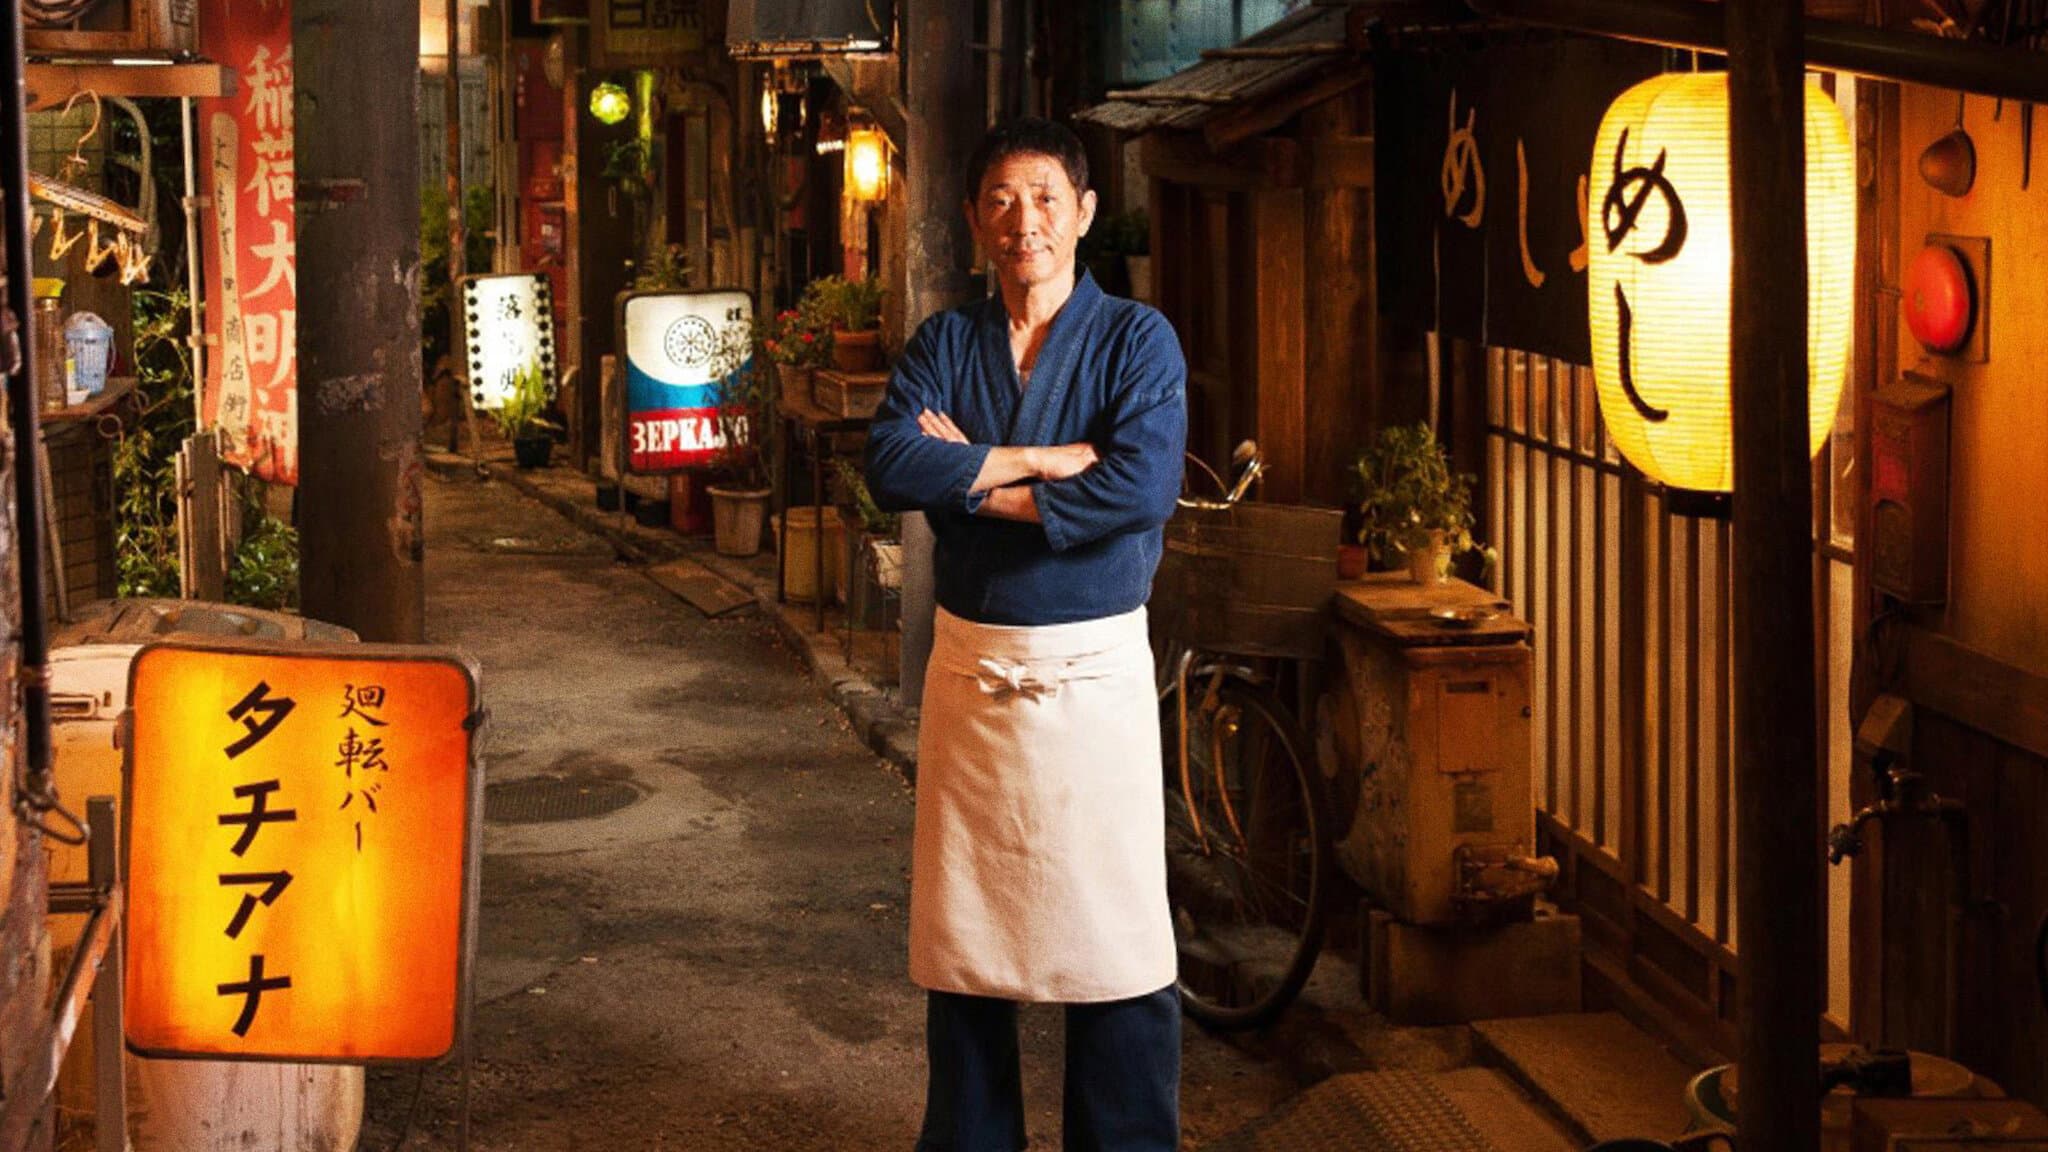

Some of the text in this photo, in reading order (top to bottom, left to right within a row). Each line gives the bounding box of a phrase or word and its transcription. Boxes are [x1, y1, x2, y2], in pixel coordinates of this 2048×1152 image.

[1601, 126, 1689, 423] めし
[217, 680, 297, 1038] タチアナ
[334, 683, 390, 851] 廻転バー
